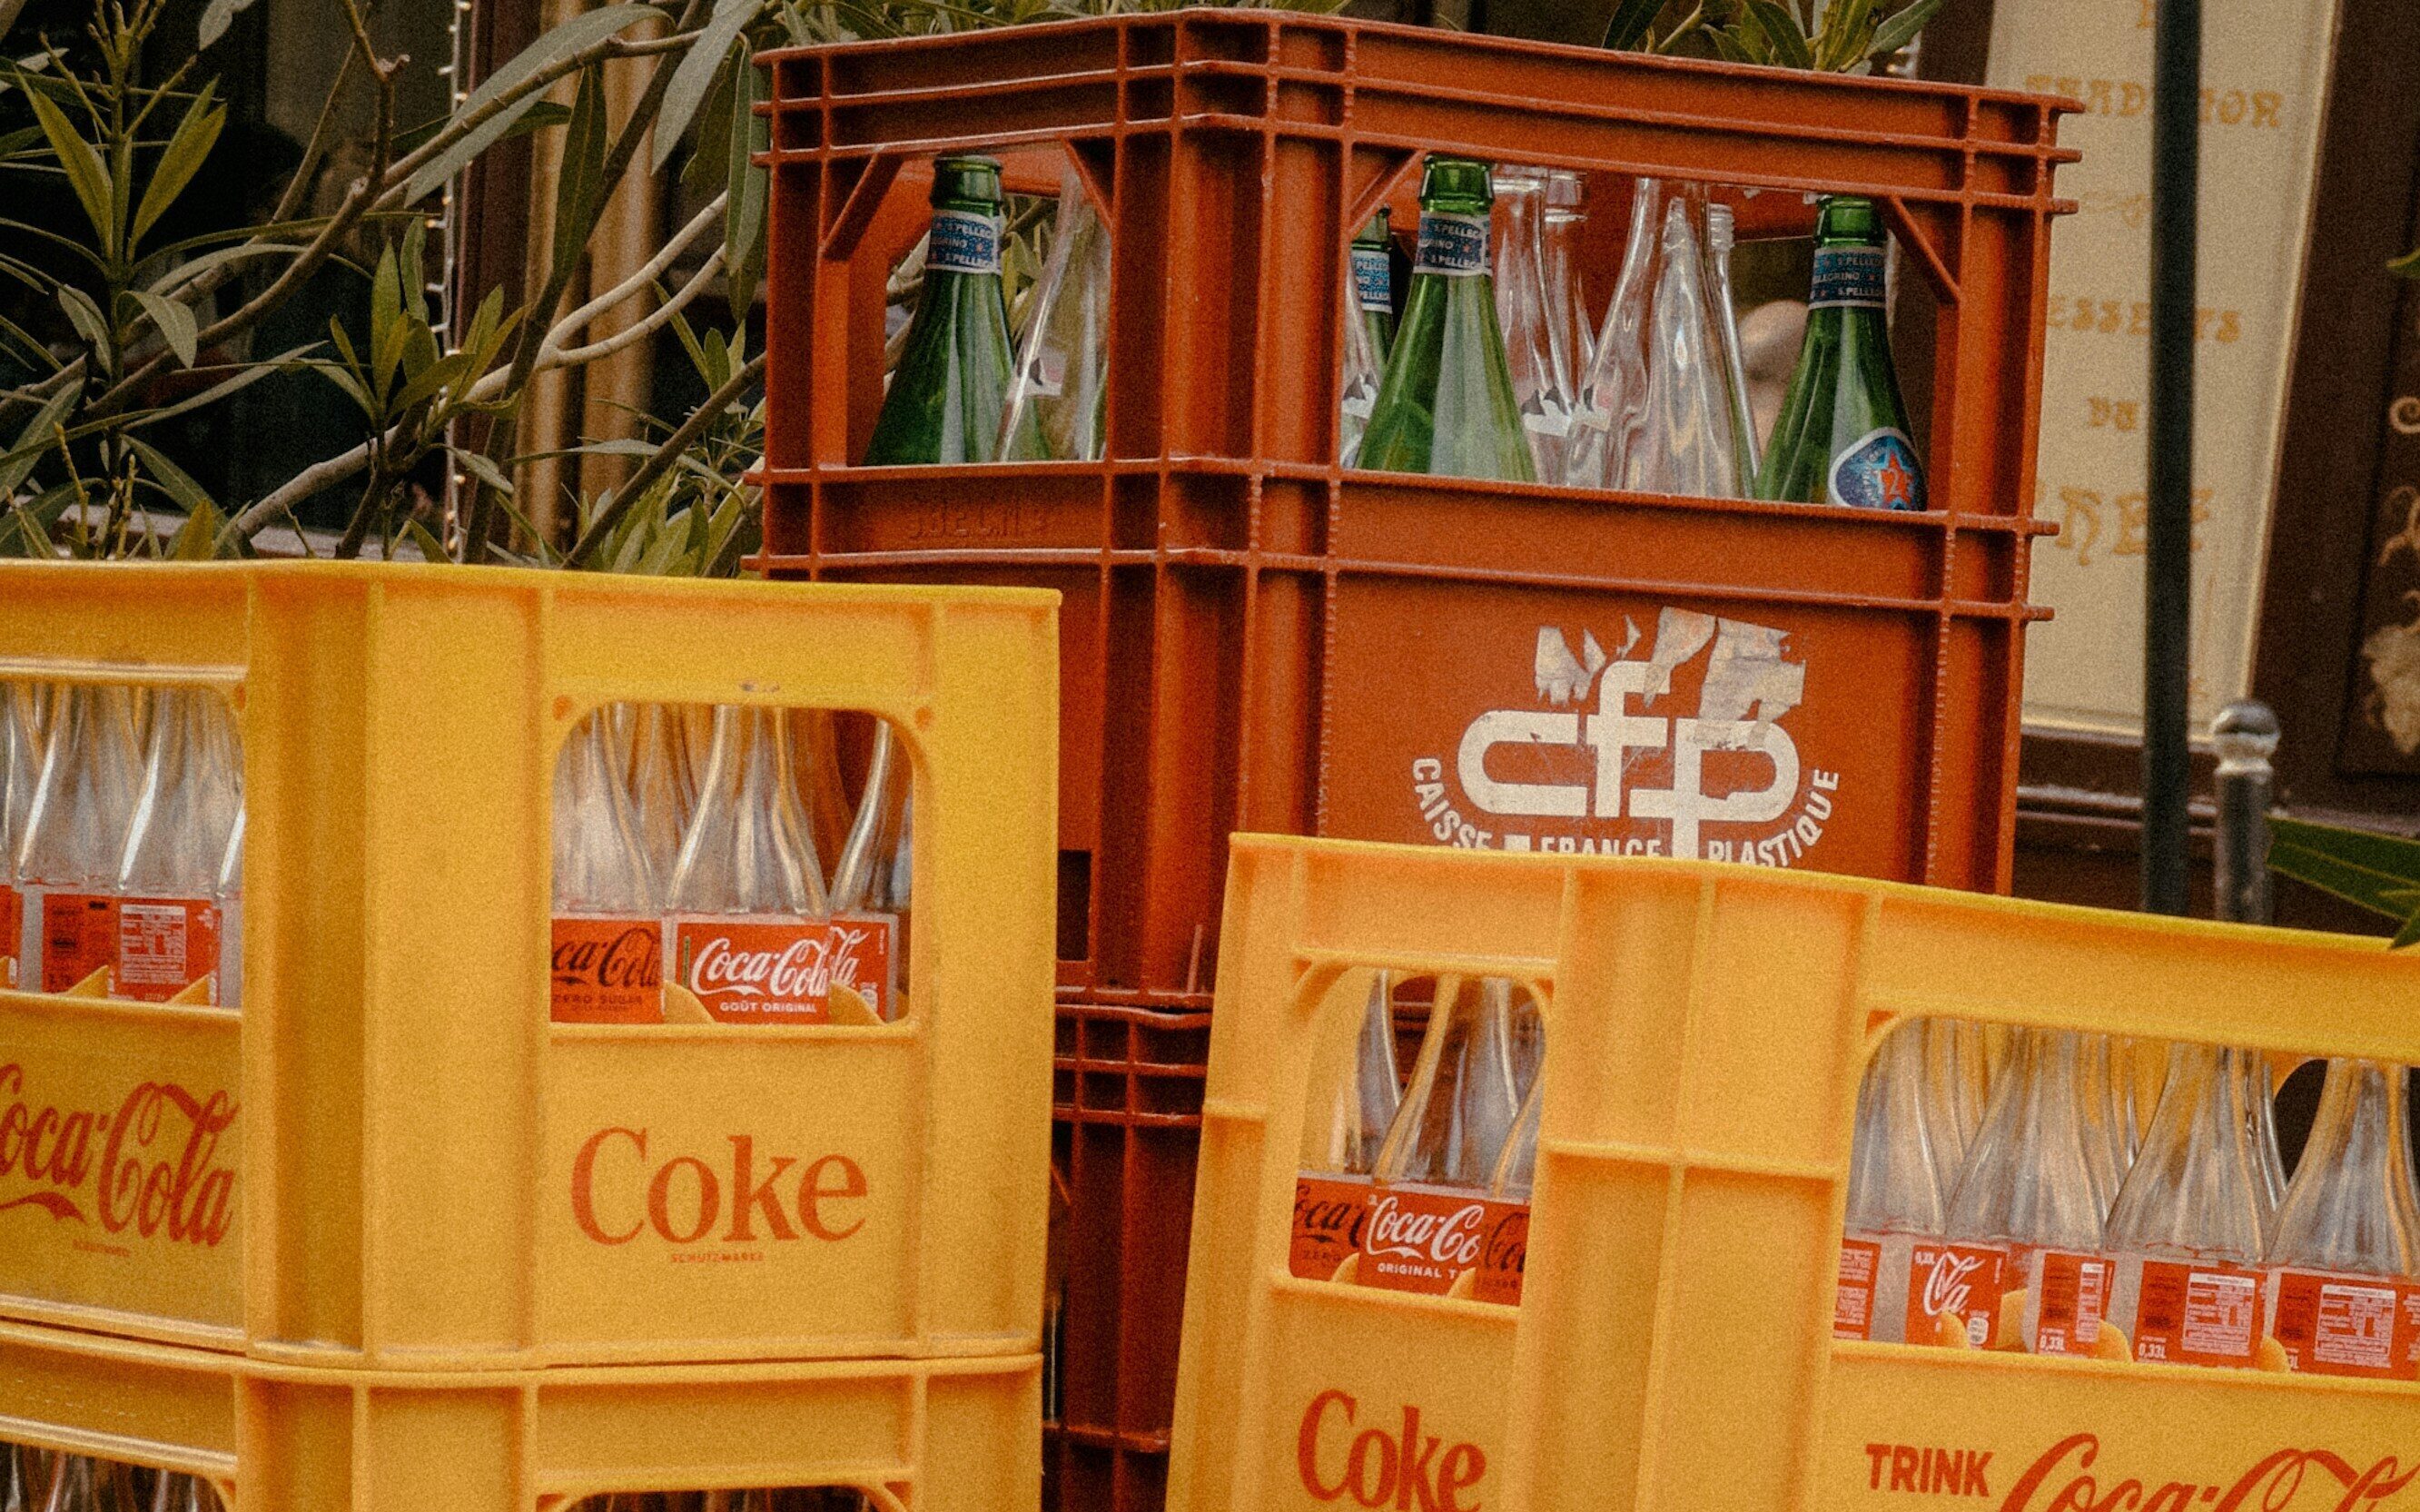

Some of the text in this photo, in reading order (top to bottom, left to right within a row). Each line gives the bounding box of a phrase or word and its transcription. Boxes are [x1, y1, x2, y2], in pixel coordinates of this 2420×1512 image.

[1412, 757, 1840, 868] CAISSE FRANCE PLASTIQUE
[719, 1000, 817, 1013] GOÛT ORIGINAL
[570, 1126, 869, 1246] Coke
[1377, 1260, 1442, 1280] ORIGINAL
[2138, 1340, 2167, 1359] 0,33L
[1297, 1388, 1487, 1512] Coke
[1865, 1443, 1993, 1497] TRINK
